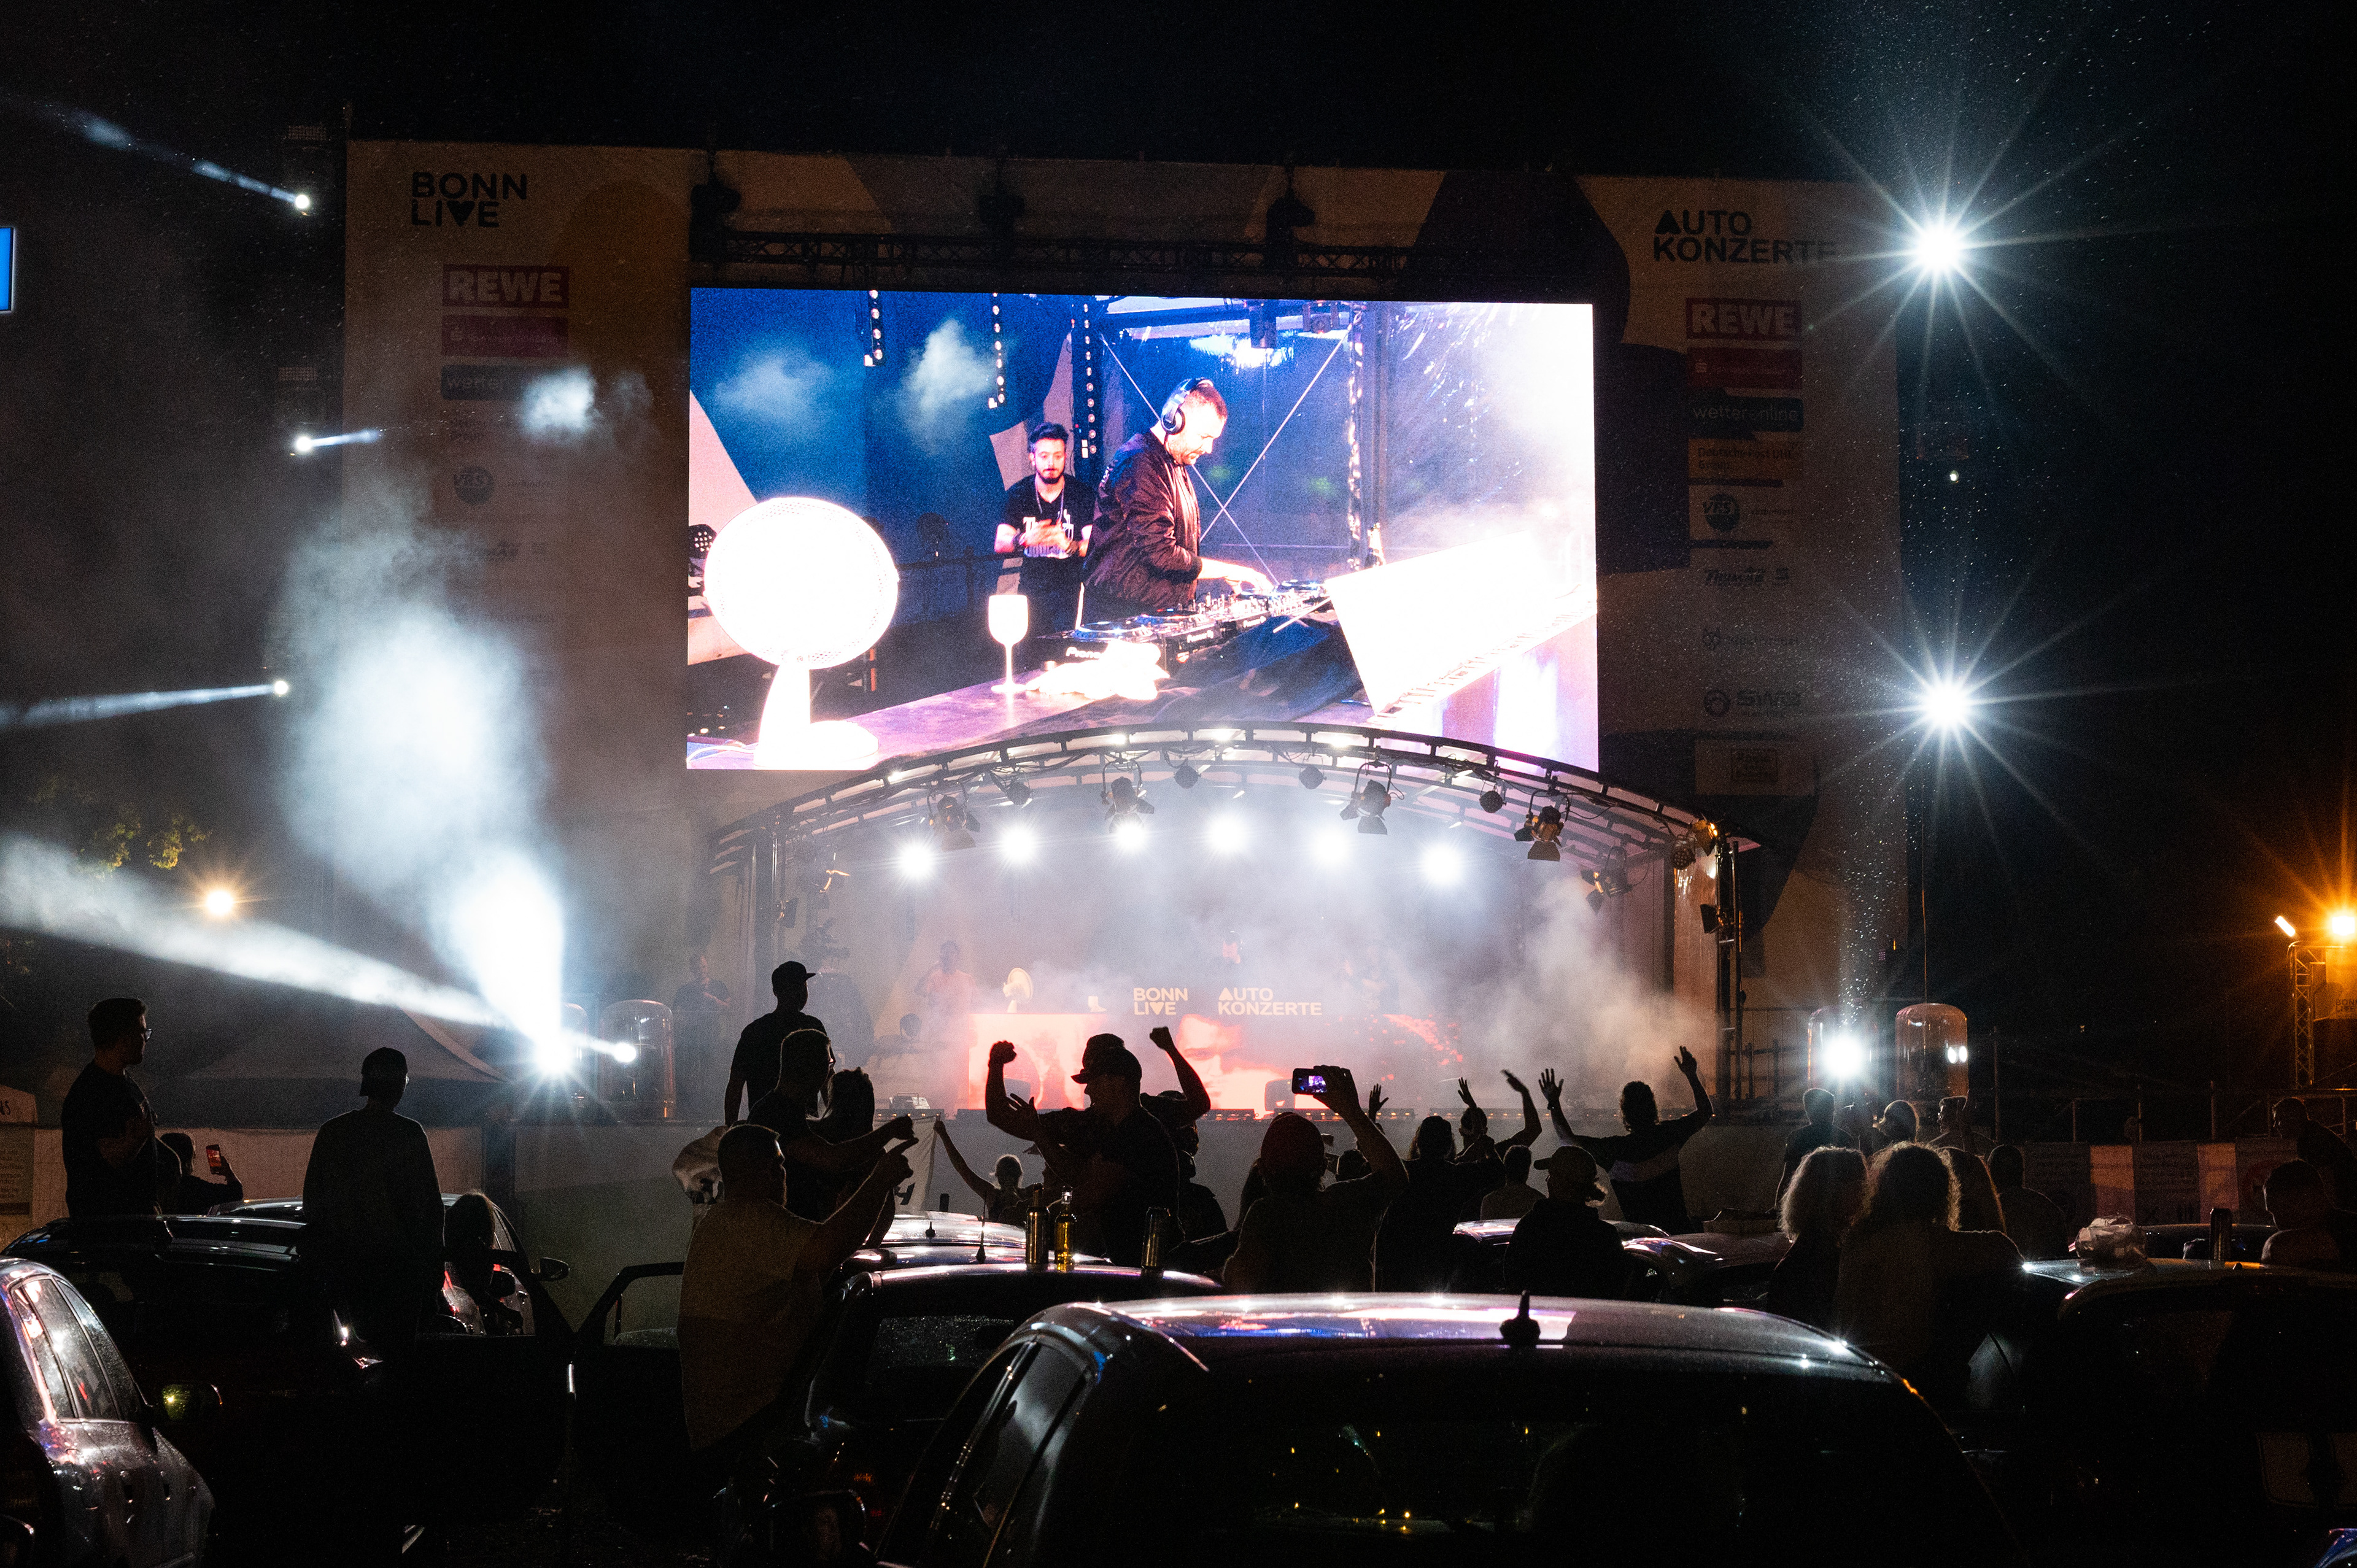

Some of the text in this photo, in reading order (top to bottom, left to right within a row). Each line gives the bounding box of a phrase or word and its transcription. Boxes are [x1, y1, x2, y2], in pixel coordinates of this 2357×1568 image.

[412, 172, 527, 199] BONN
[411, 199, 500, 227] LIVE
[1654, 209, 1752, 236] AUTO
[1654, 236, 1835, 263] KONZERTE
[449, 269, 563, 303] REWE
[1691, 303, 1796, 336] REWE
[1066, 646, 1101, 659] Pione
[1133, 987, 1188, 1001] BONN
[1218, 987, 1274, 1001] AUTO
[1134, 1002, 1177, 1015] LIVE
[1218, 1002, 1322, 1015] KONZERTE
